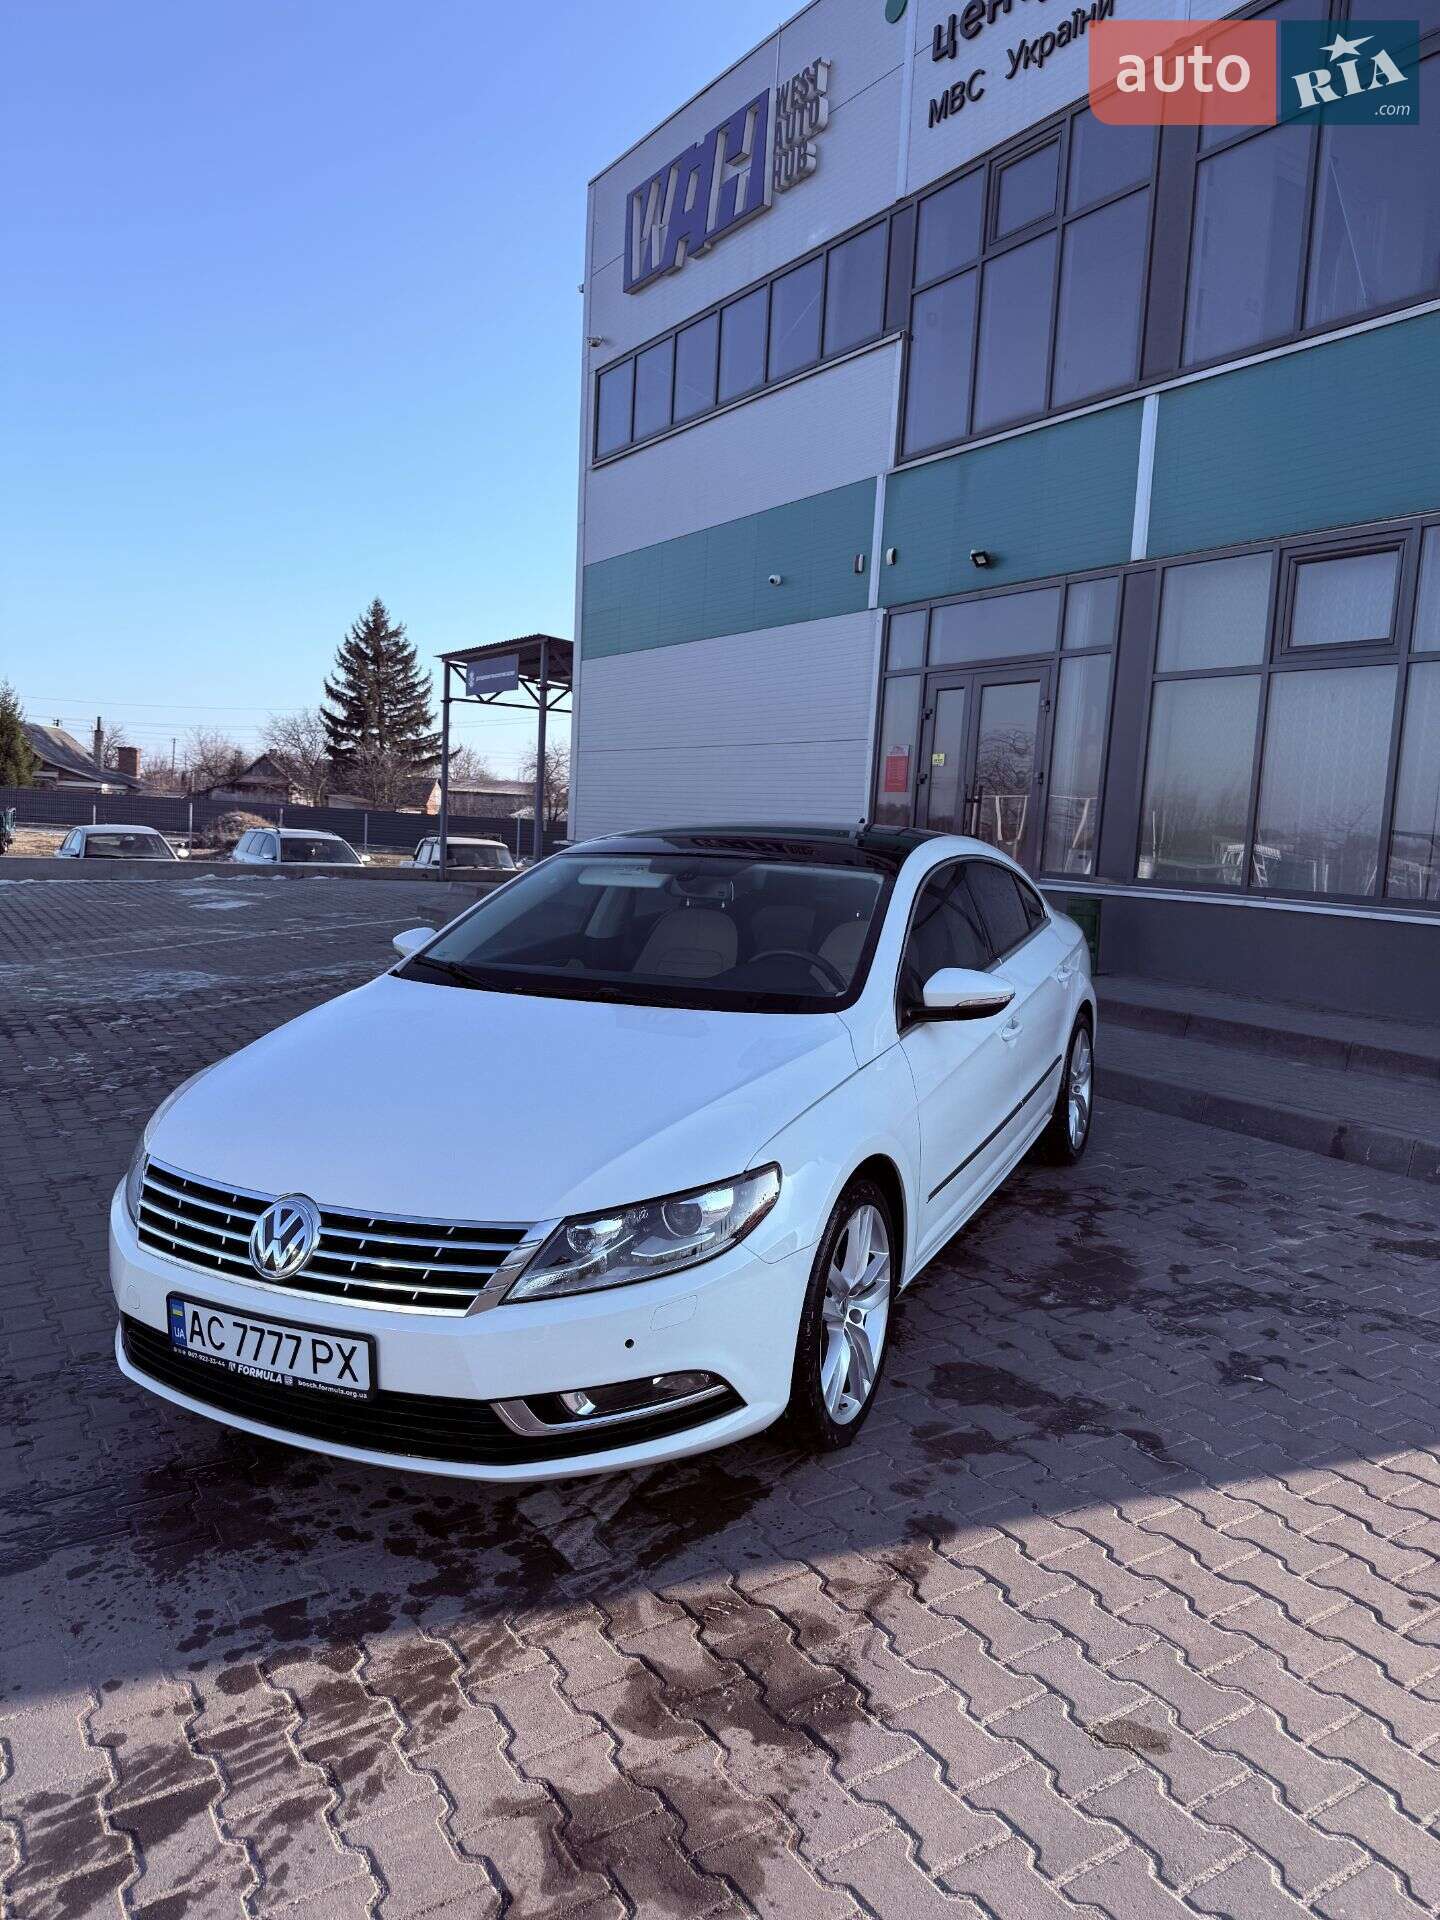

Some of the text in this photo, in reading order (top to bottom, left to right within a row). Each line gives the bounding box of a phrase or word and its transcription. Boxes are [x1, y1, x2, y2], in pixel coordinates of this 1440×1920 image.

[928, 69, 986, 128] МВС
[623, 87, 773, 295] WAH
[189, 1310, 359, 1382] AC 7777 PX
[237, 1364, 283, 1384] FORMULA
